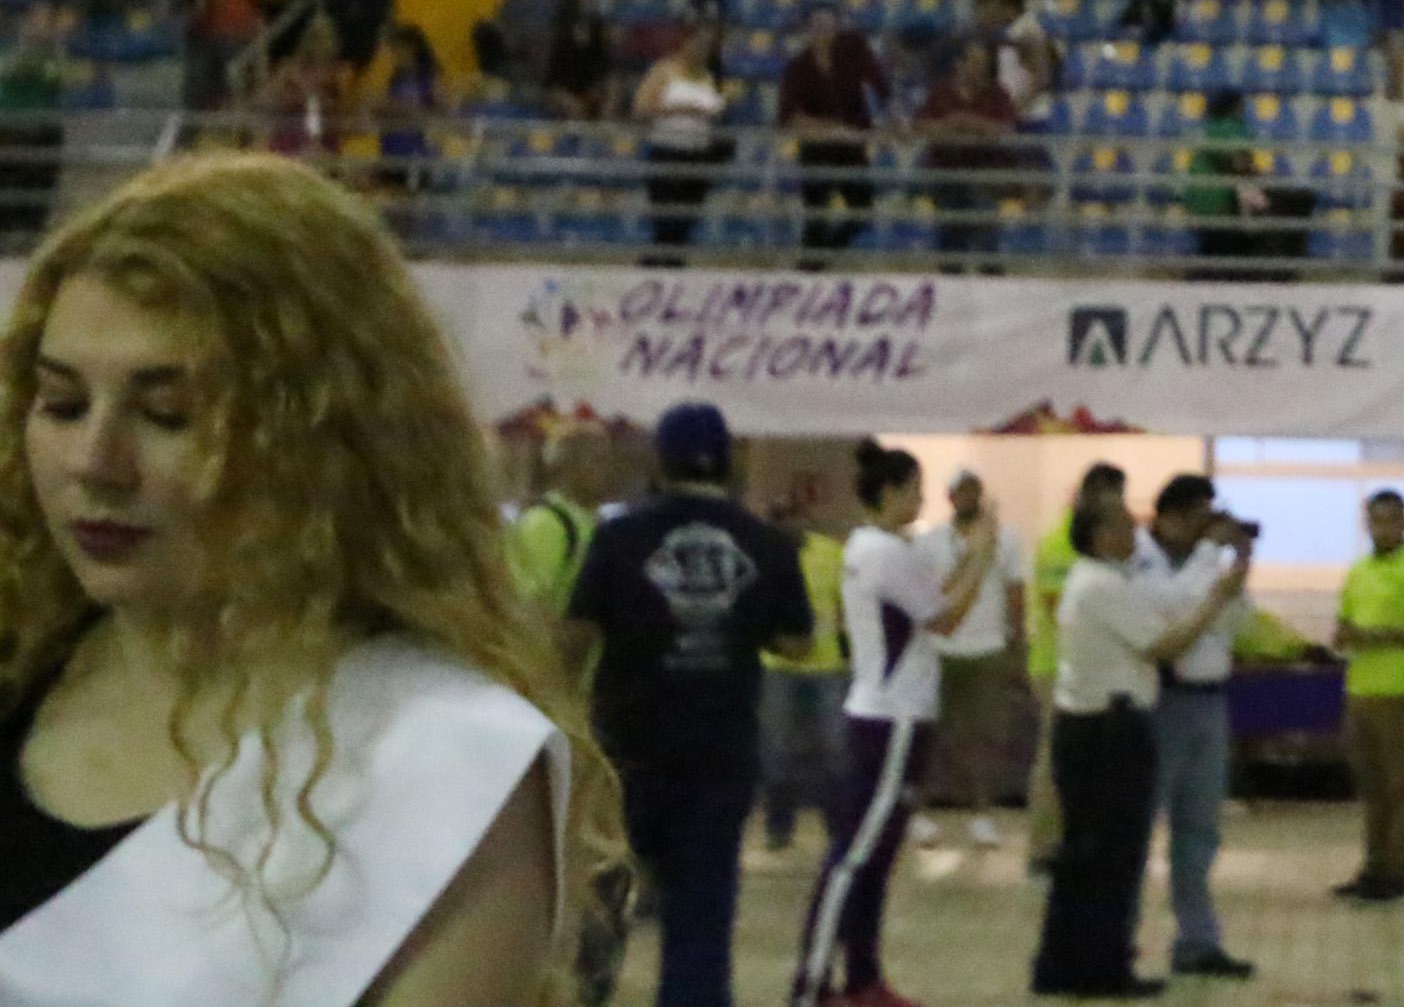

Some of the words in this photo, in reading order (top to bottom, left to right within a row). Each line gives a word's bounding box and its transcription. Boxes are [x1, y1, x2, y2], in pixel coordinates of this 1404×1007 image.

[618, 278, 938, 332] OLIMPIADA
[618, 331, 927, 382] NACIONAL
[1138, 303, 1375, 368] ARZYZ
